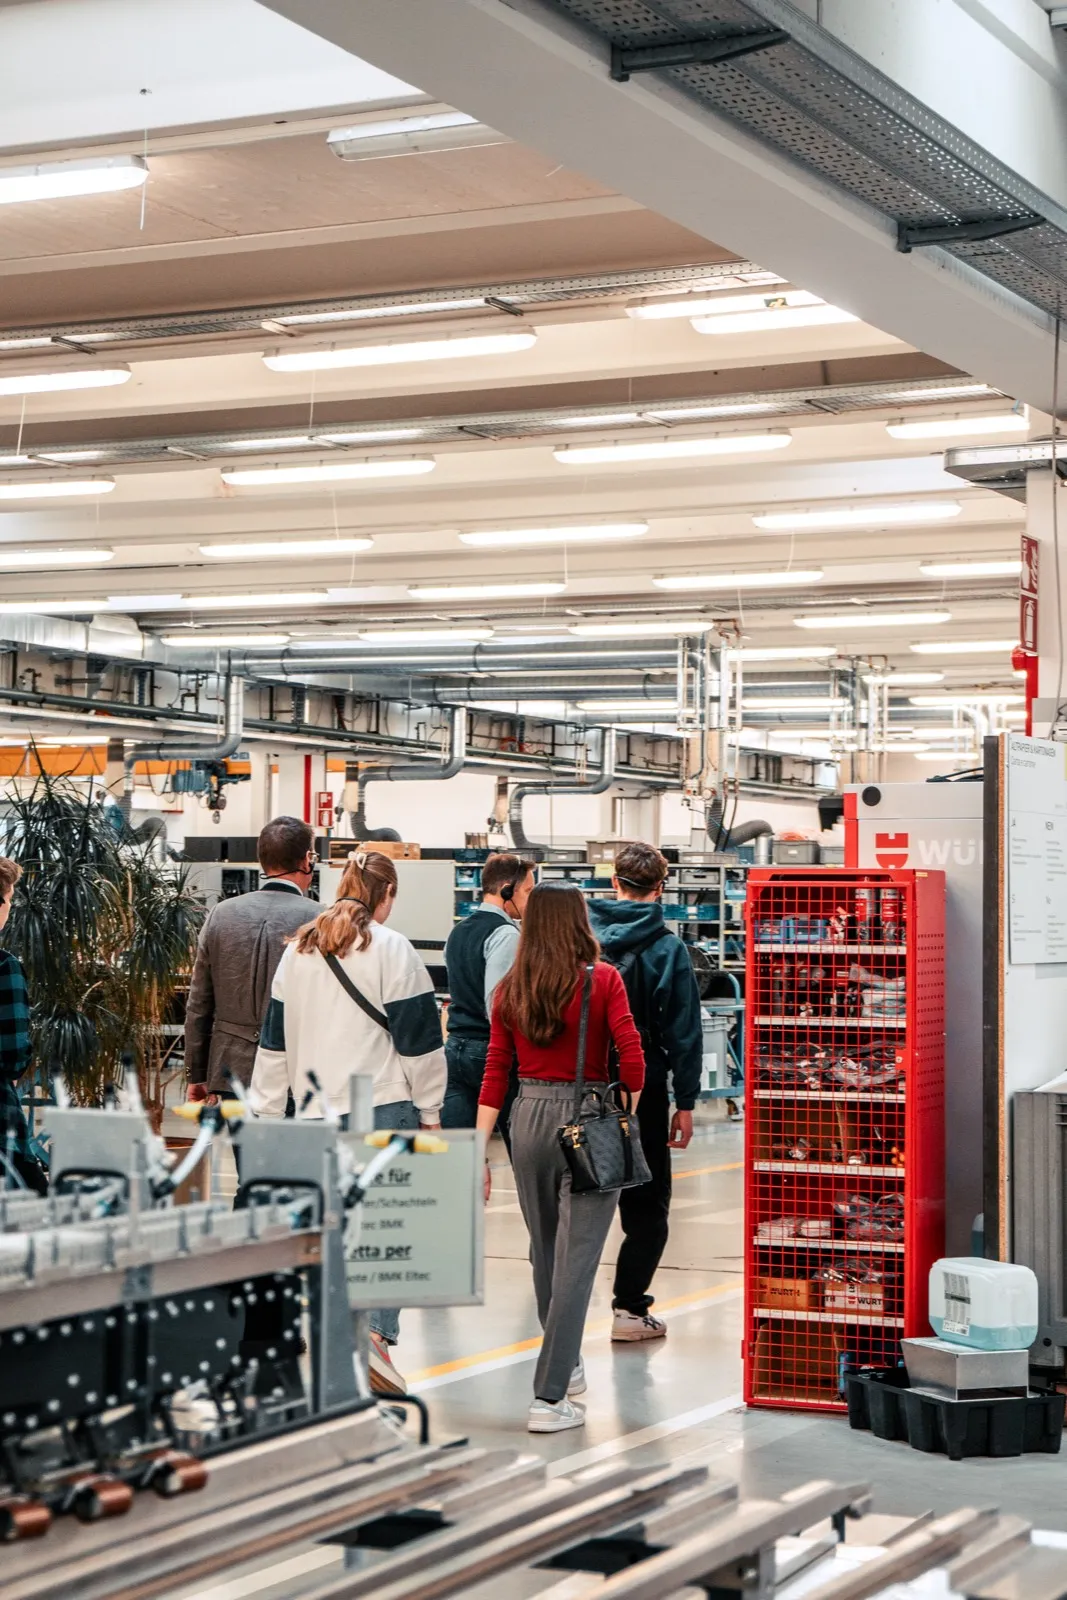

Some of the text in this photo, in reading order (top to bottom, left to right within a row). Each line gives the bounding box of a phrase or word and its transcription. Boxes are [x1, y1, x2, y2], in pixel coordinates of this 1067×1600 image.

[918, 838, 983, 865] WÜ
[372, 1168, 412, 1184] e für
[380, 1218, 403, 1230] BMK
[385, 1245, 412, 1260] per
[378, 1271, 402, 1282] BMK
